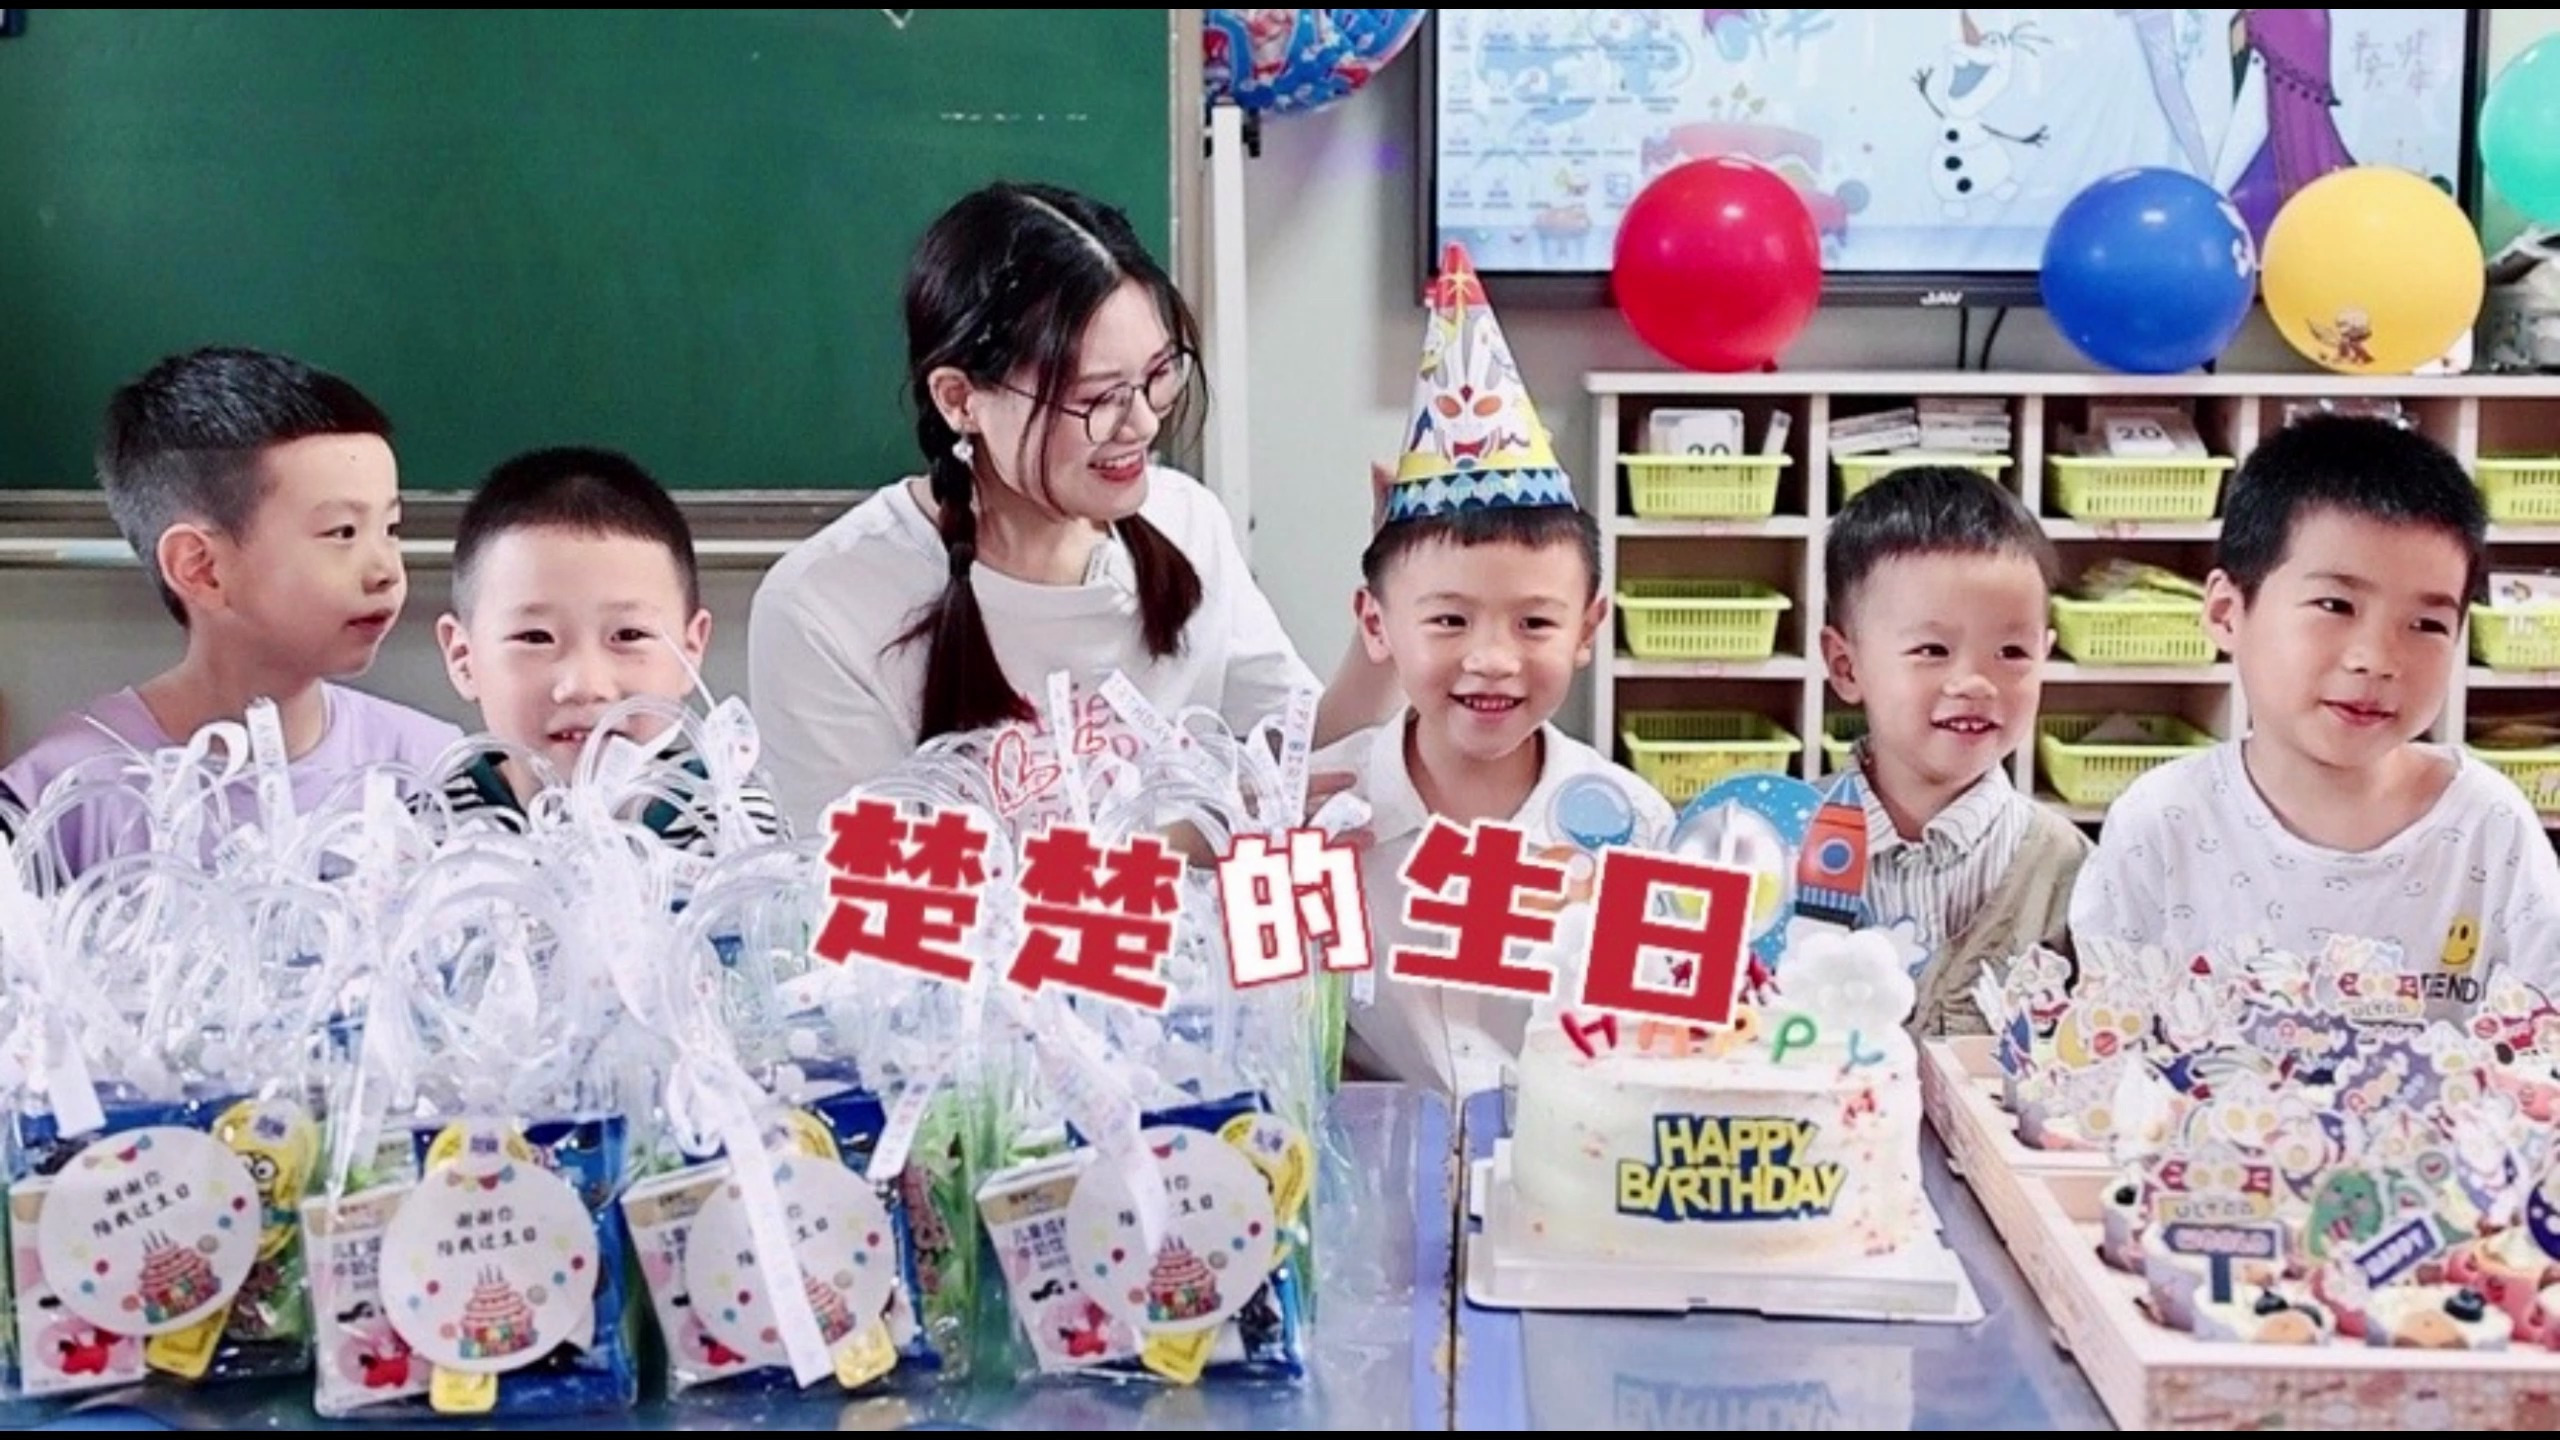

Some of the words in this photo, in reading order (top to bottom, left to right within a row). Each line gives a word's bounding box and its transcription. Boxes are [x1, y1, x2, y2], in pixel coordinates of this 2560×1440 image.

[1657, 1117, 1819, 1167] HAPPY
[92, 1182, 191, 1237] 陪我过生日
[1618, 1160, 1848, 1221] BIRTHDAY
[437, 1226, 537, 1256] 陪我过生日
[456, 1205, 514, 1229] 谢谢你
